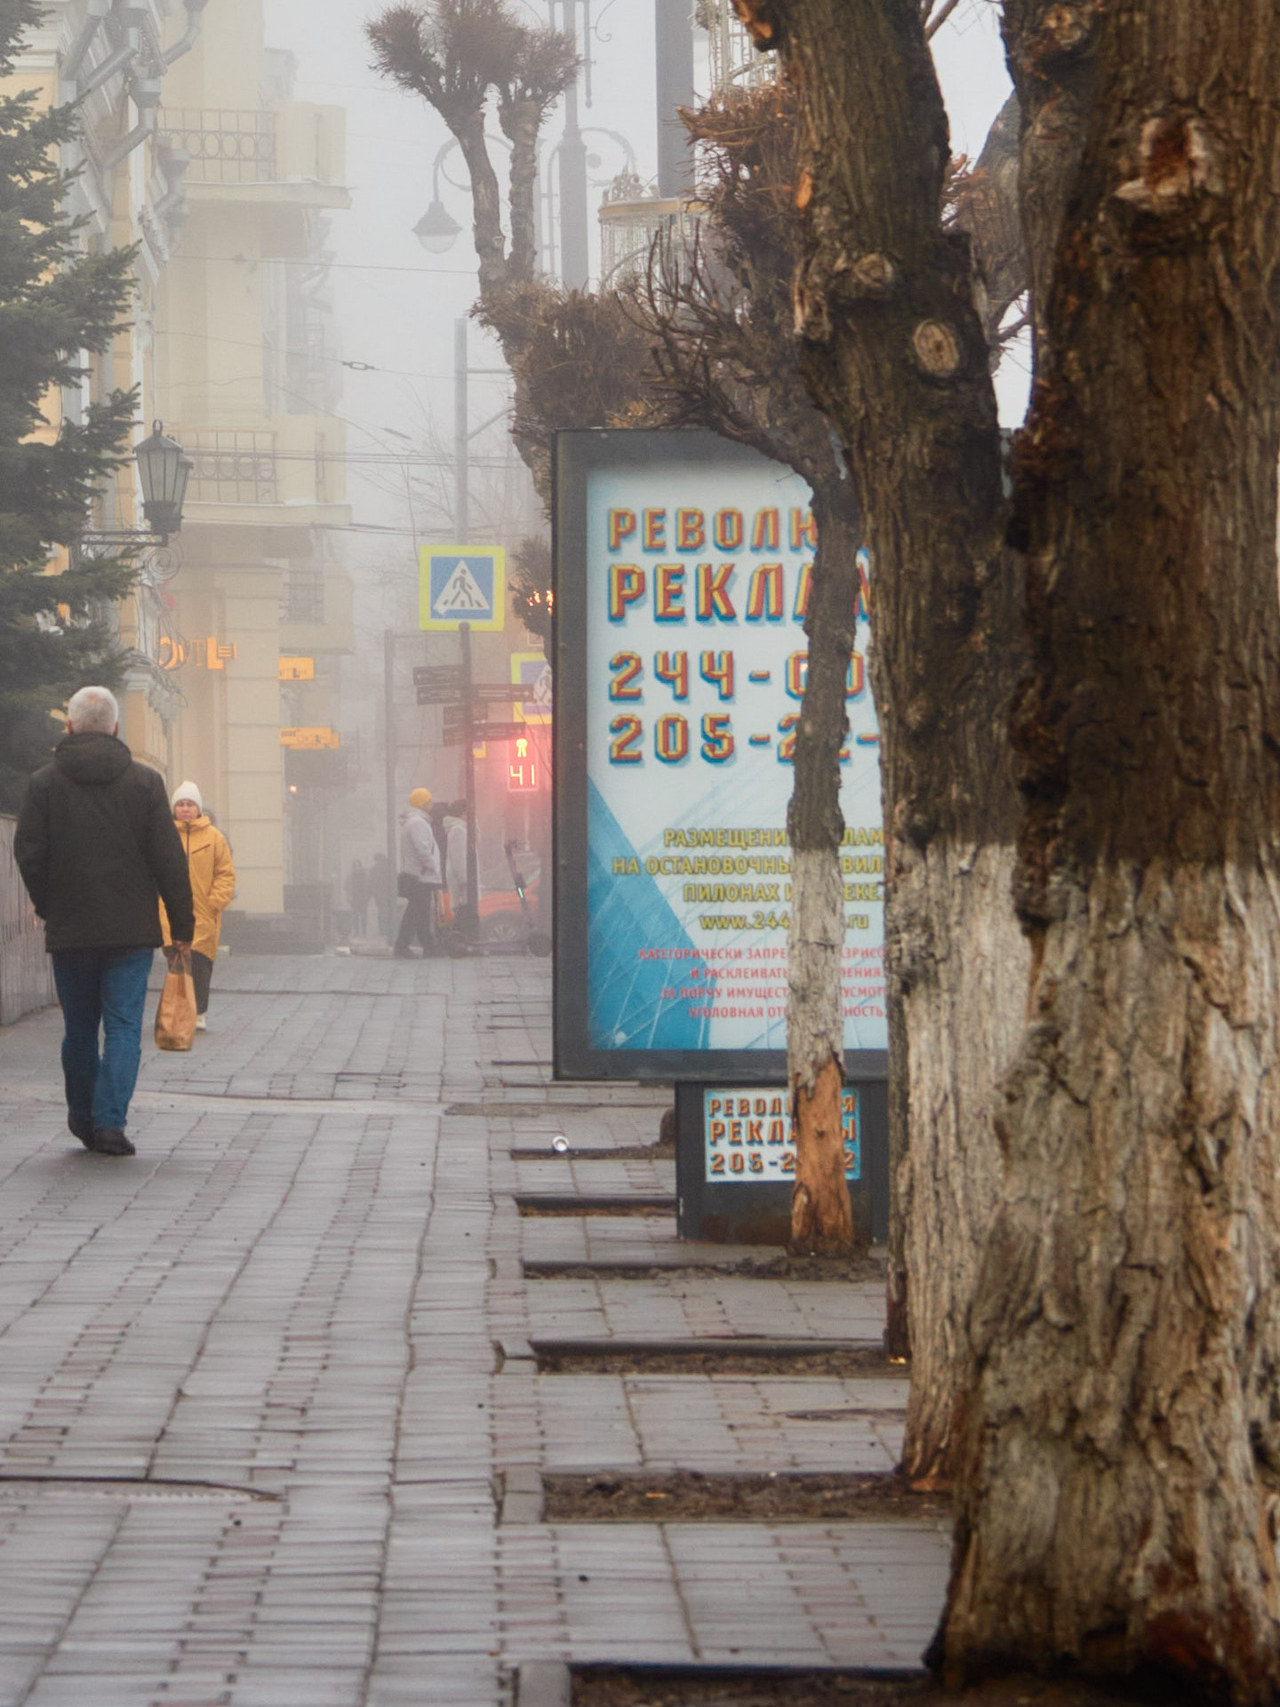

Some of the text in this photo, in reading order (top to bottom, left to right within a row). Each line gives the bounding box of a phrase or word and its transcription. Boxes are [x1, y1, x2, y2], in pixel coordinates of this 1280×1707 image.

[608, 561, 871, 622] РЕКЛ
[608, 649, 865, 703] 244-00
[509, 763, 536, 786] 41
[663, 827, 788, 850] РАЗМЕЩЕНИ
[612, 856, 793, 875] НА ОСТАНОВОЧНЫ
[682, 883, 780, 903] ПИЛОНАХ
[699, 911, 869, 930] www.244.ru
[638, 947, 787, 960] КАТЕГОРИЧЕСКИ ЗАПРЕ
[690, 967, 699, 979] И
[661, 987, 787, 1000] ЗА ПОРЧУ ИМУЩЕСТ
[689, 1007, 764, 1018] УГОЛОВНАЯ
[709, 1096, 856, 1118] РЕВОЛЯ
[709, 1118, 856, 1146] РЕКЛАЫ
[710, 1150, 856, 1175] 205-22
